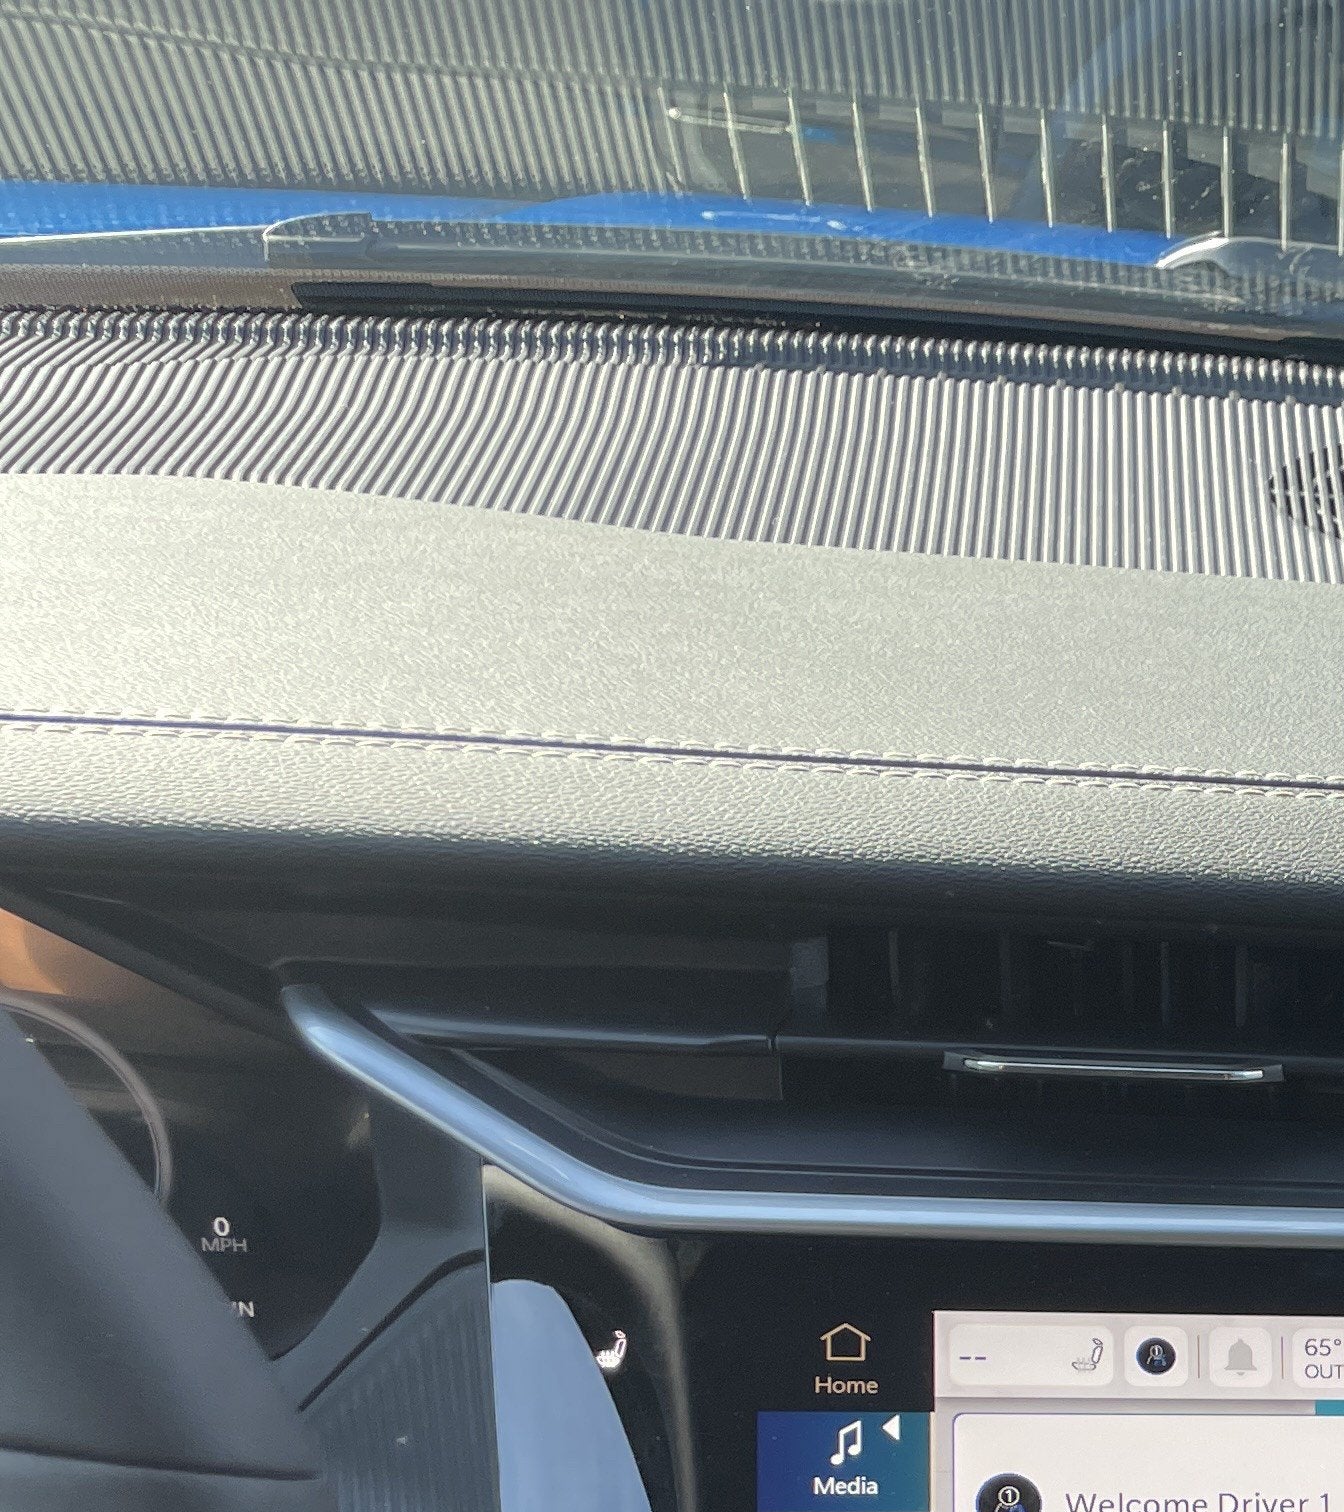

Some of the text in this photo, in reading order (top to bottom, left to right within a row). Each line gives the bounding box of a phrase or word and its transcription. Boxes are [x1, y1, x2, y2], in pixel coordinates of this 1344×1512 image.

[213, 1216, 230, 1237] 0
[201, 1237, 247, 1253] MPH
[1304, 1337, 1343, 1357] 65°
[1304, 1363, 1344, 1381] OUT
[814, 1376, 879, 1395] Home
[813, 1476, 879, 1496] Media
